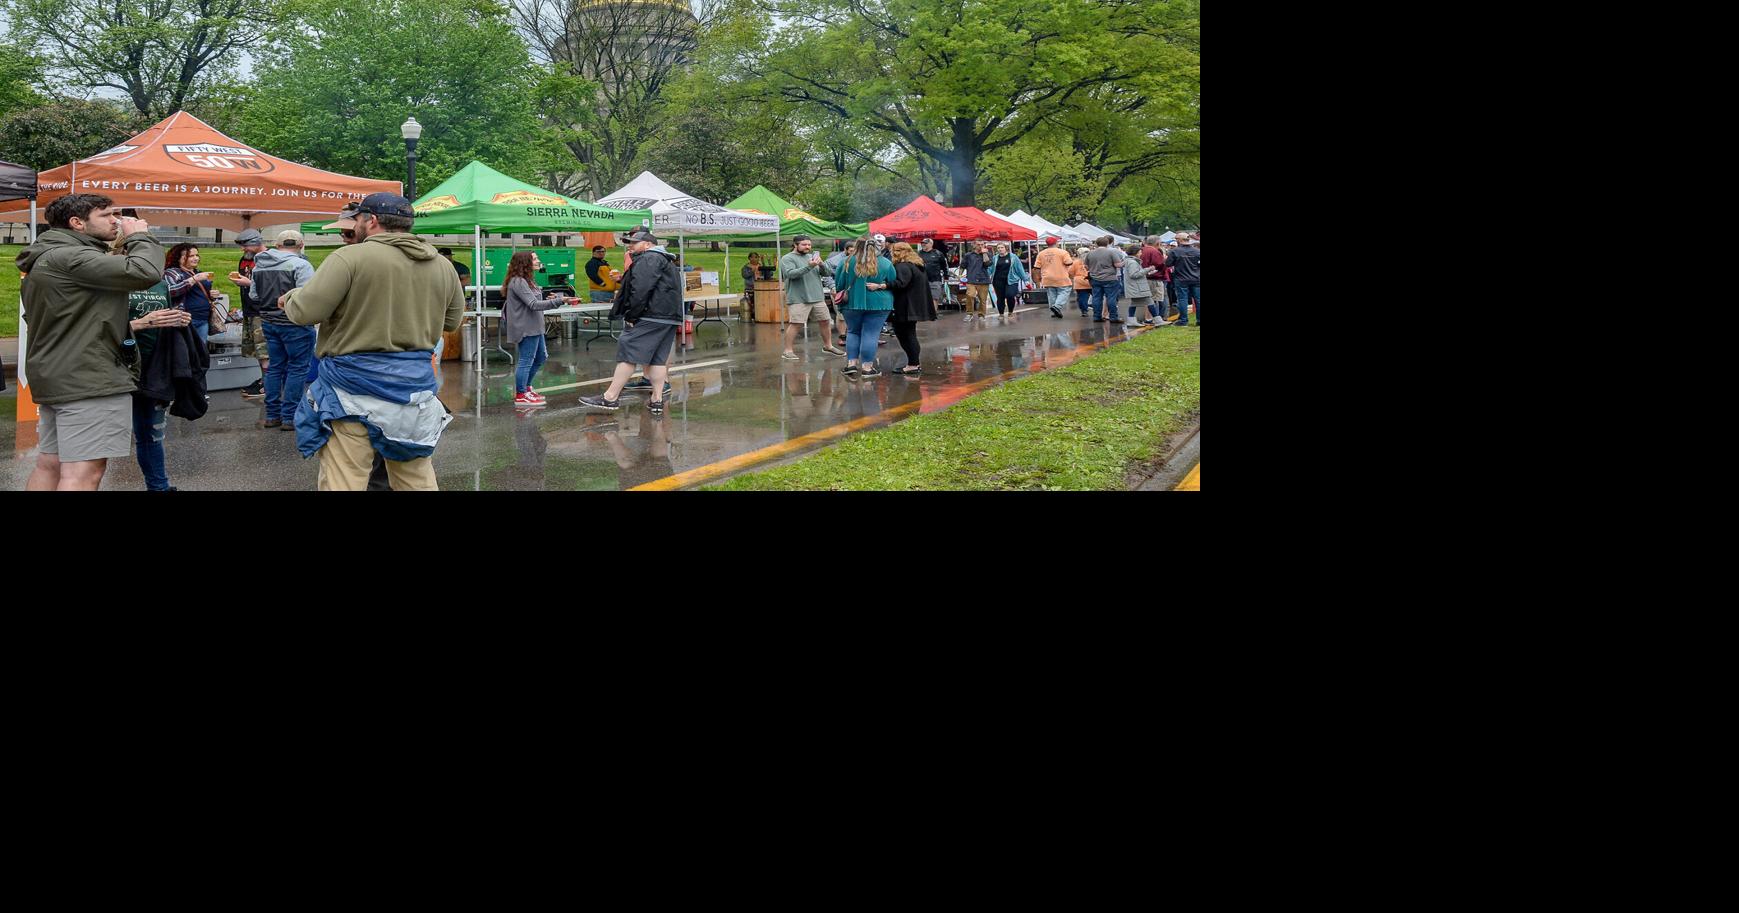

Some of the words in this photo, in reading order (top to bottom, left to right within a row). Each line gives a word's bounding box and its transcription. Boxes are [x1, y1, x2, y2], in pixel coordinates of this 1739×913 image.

[82, 180, 131, 190] EVERY
[135, 183, 170, 192] BEER
[175, 184, 187, 193] IS
[205, 186, 268, 196] JOURNEY.
[271, 188, 299, 197] JOIN
[303, 190, 318, 198] US
[321, 191, 343, 199] FOR
[348, 192, 368, 200] THE
[526, 207, 568, 218] SIERRA
[572, 209, 615, 220] NEVADA
[686, 215, 699, 225] NO
[700, 213, 717, 225] B.S.
[719, 216, 737, 226] JUST
